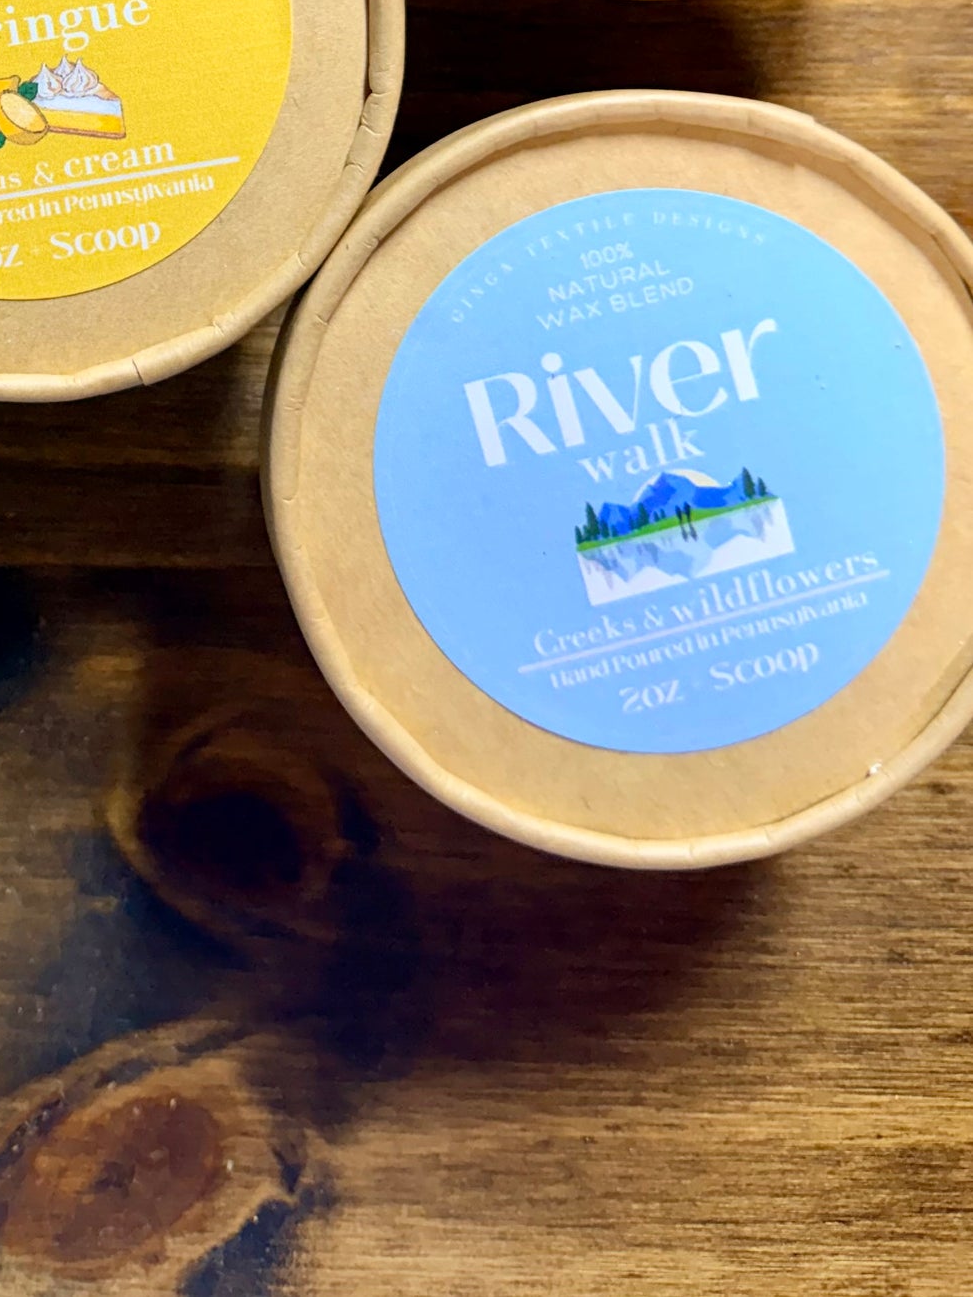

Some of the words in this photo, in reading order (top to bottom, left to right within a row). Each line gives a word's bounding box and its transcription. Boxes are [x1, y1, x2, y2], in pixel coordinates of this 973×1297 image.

[33, 161, 54, 186] &
[64, 141, 176, 178] cream
[40, 198, 60, 217] in
[64, 173, 214, 208] Pennsylvania
[50, 220, 161, 260] Scoop
[526, 213, 635, 257] TEXTILE
[653, 211, 767, 245] DESIGNS
[580, 242, 635, 270] 100%
[536, 300, 603, 330] WAX
[609, 276, 694, 313] BLEND
[548, 260, 670, 302] NATURAL
[464, 317, 778, 466] River
[578, 417, 706, 484] walk
[534, 615, 636, 657] Creeks
[643, 605, 664, 630] &
[670, 551, 880, 625] wildflowers
[550, 662, 610, 690] Hand
[721, 592, 867, 644] Pennsylvania
[709, 642, 820, 691] Scoop
